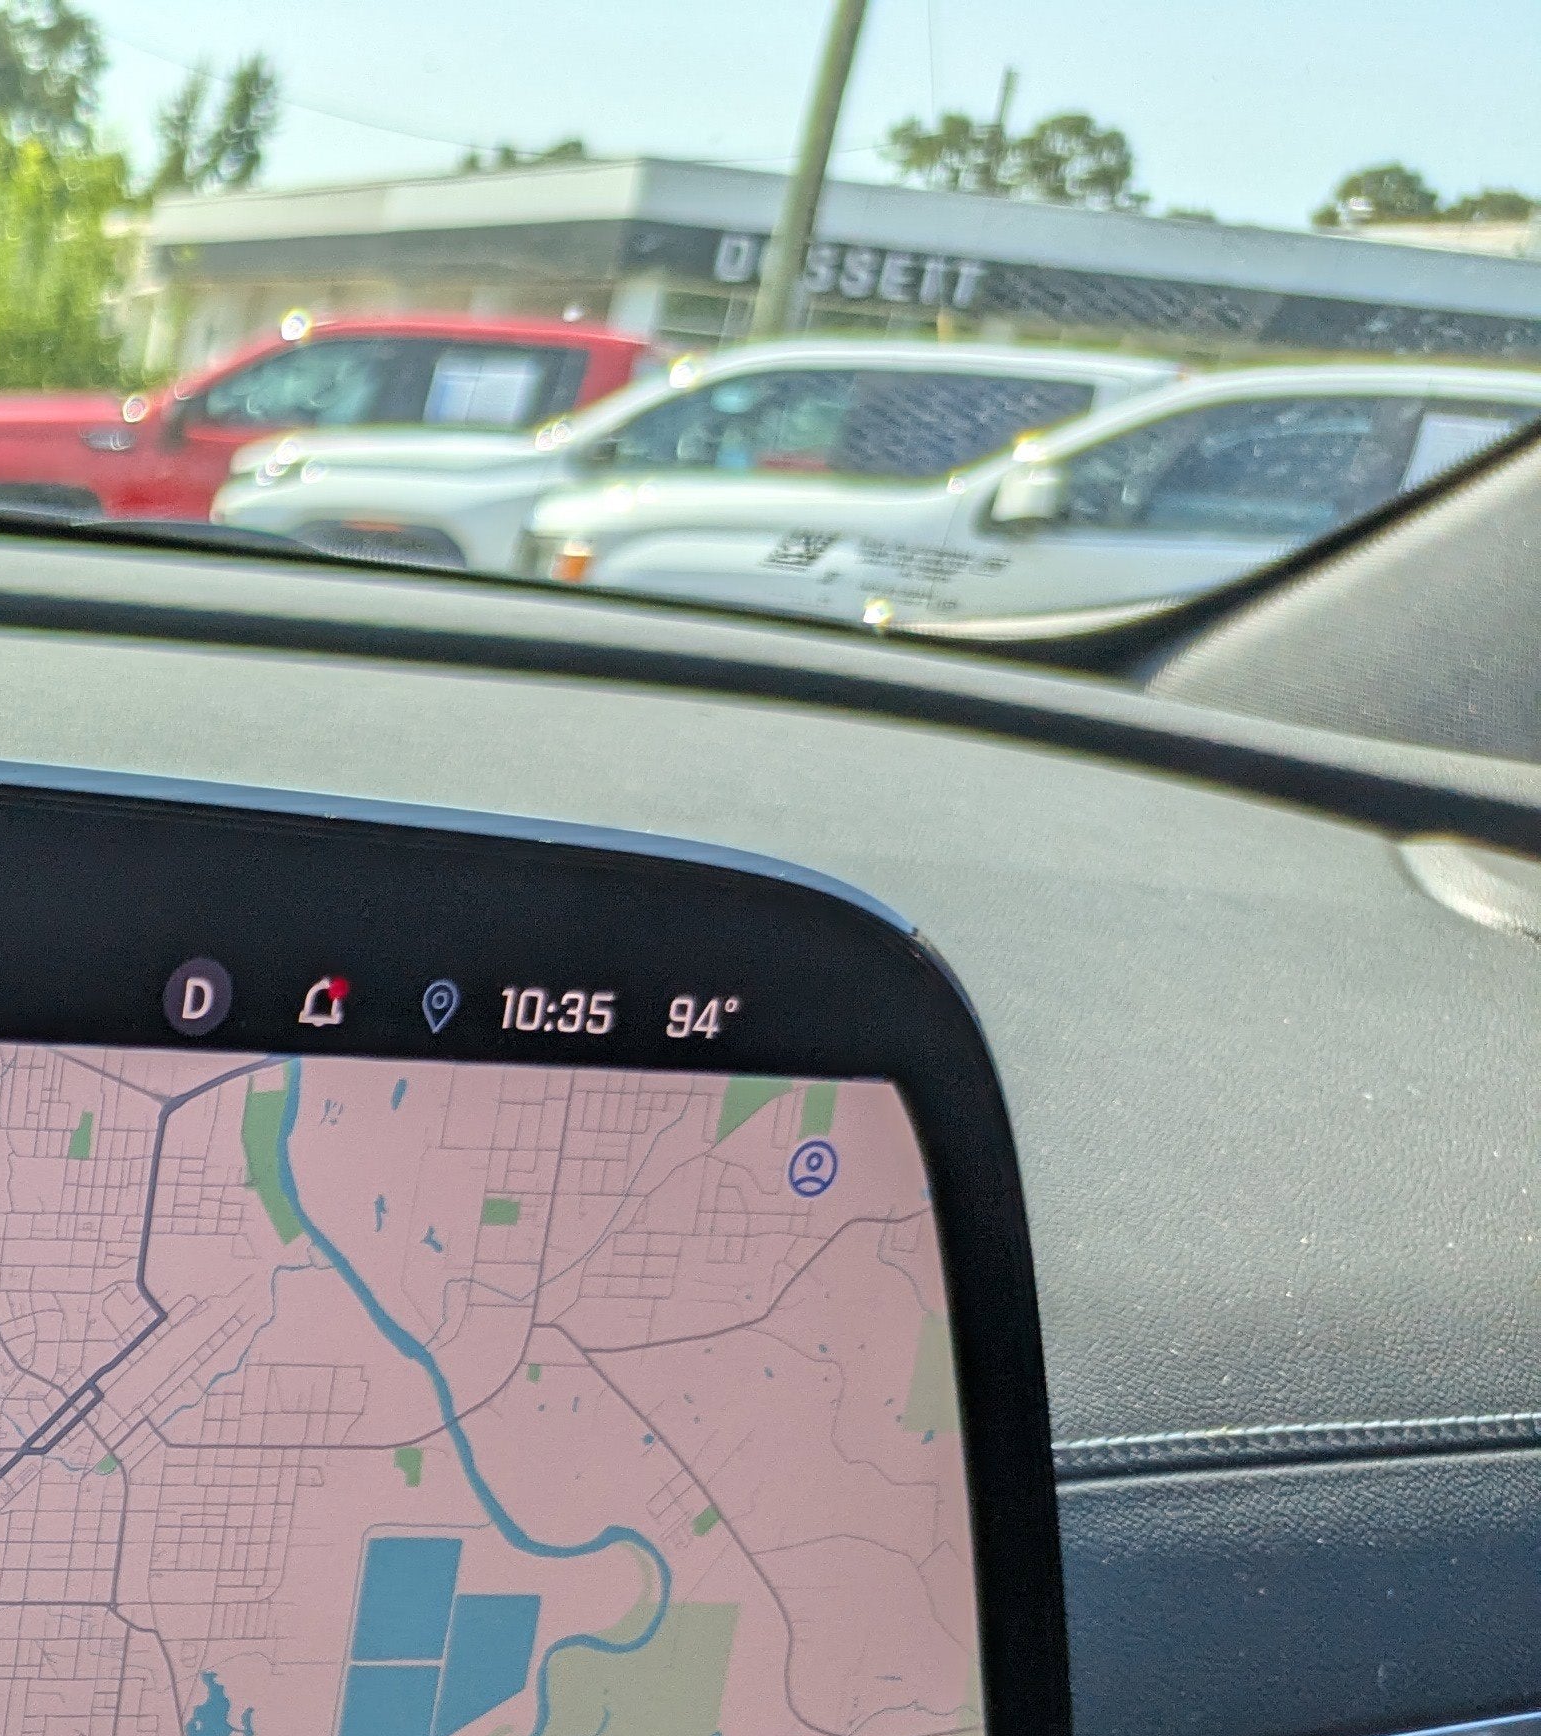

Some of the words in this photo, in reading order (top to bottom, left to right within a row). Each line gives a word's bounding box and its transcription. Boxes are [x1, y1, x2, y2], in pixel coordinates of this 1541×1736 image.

[715, 233, 989, 309] DSSETT
[501, 987, 616, 1036] 10:35
[665, 995, 740, 1040] 94°
